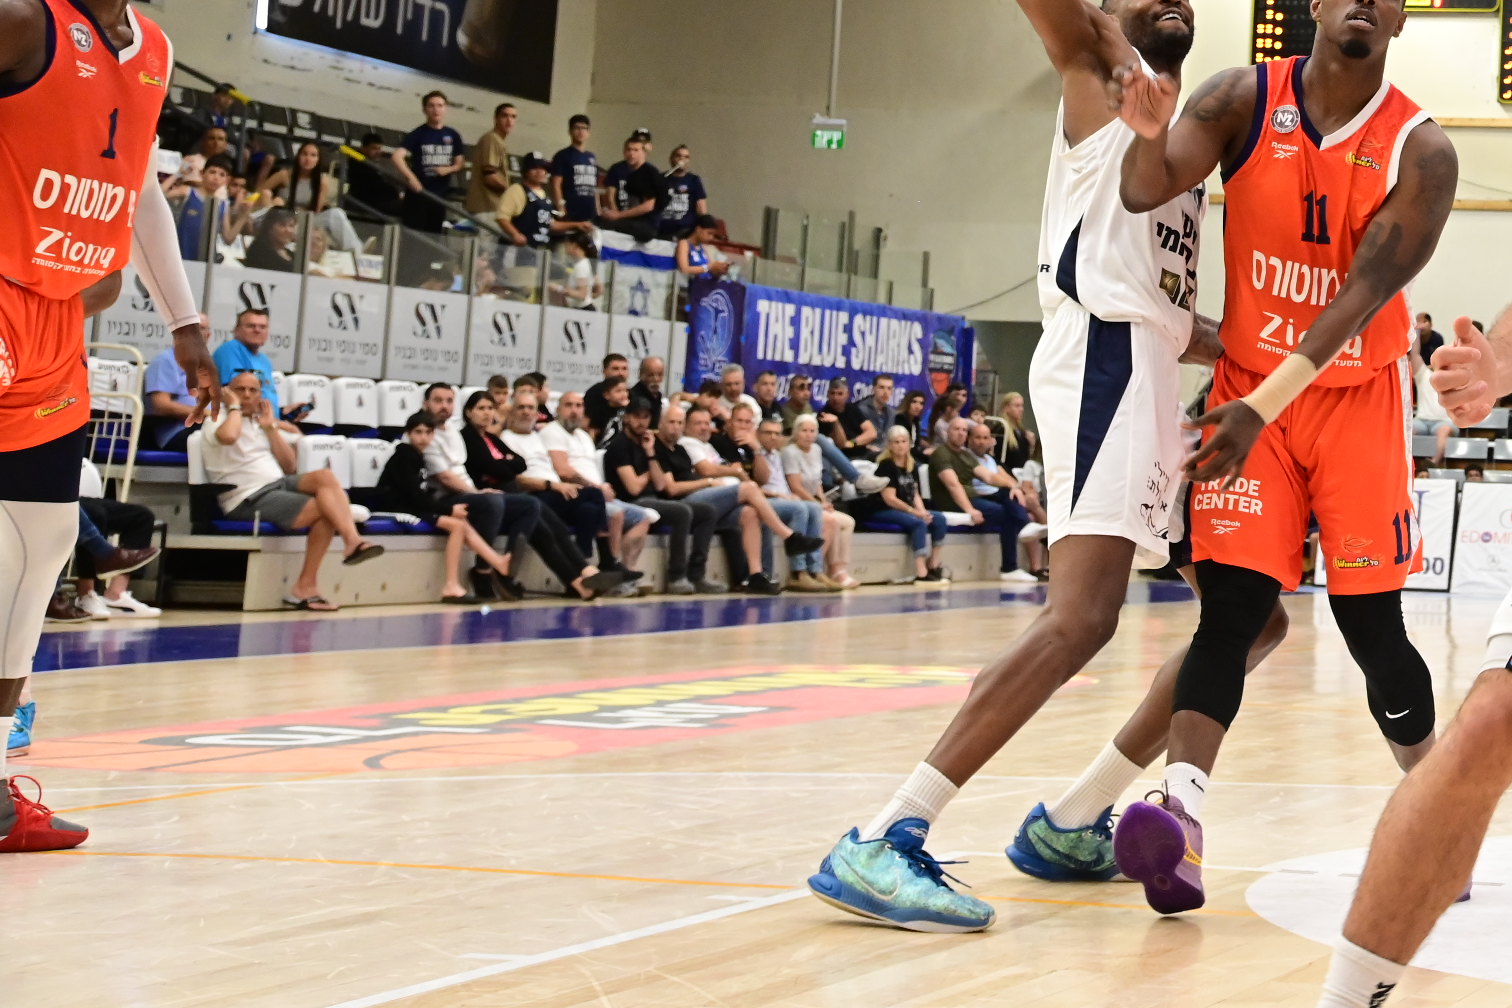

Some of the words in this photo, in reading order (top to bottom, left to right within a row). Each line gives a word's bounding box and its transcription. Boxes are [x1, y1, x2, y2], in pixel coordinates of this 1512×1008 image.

[100, 107, 119, 159] 1
[1276, 112, 1294, 126] NZ
[32, 167, 125, 223] מוטורס
[1301, 188, 1331, 245] 11
[34, 226, 116, 269] Ziona
[1252, 249, 1343, 306] מוטורס
[756, 298, 796, 362] THE
[799, 305, 849, 369] BLUE
[851, 312, 924, 377] SHARKS
[1259, 311, 1363, 359] Zia
[1194, 493, 1263, 516] CENTER
[1210, 518, 1241, 528] Reebok
[1393, 509, 1412, 566] 11
[1337, 558, 1370, 569] Winner
